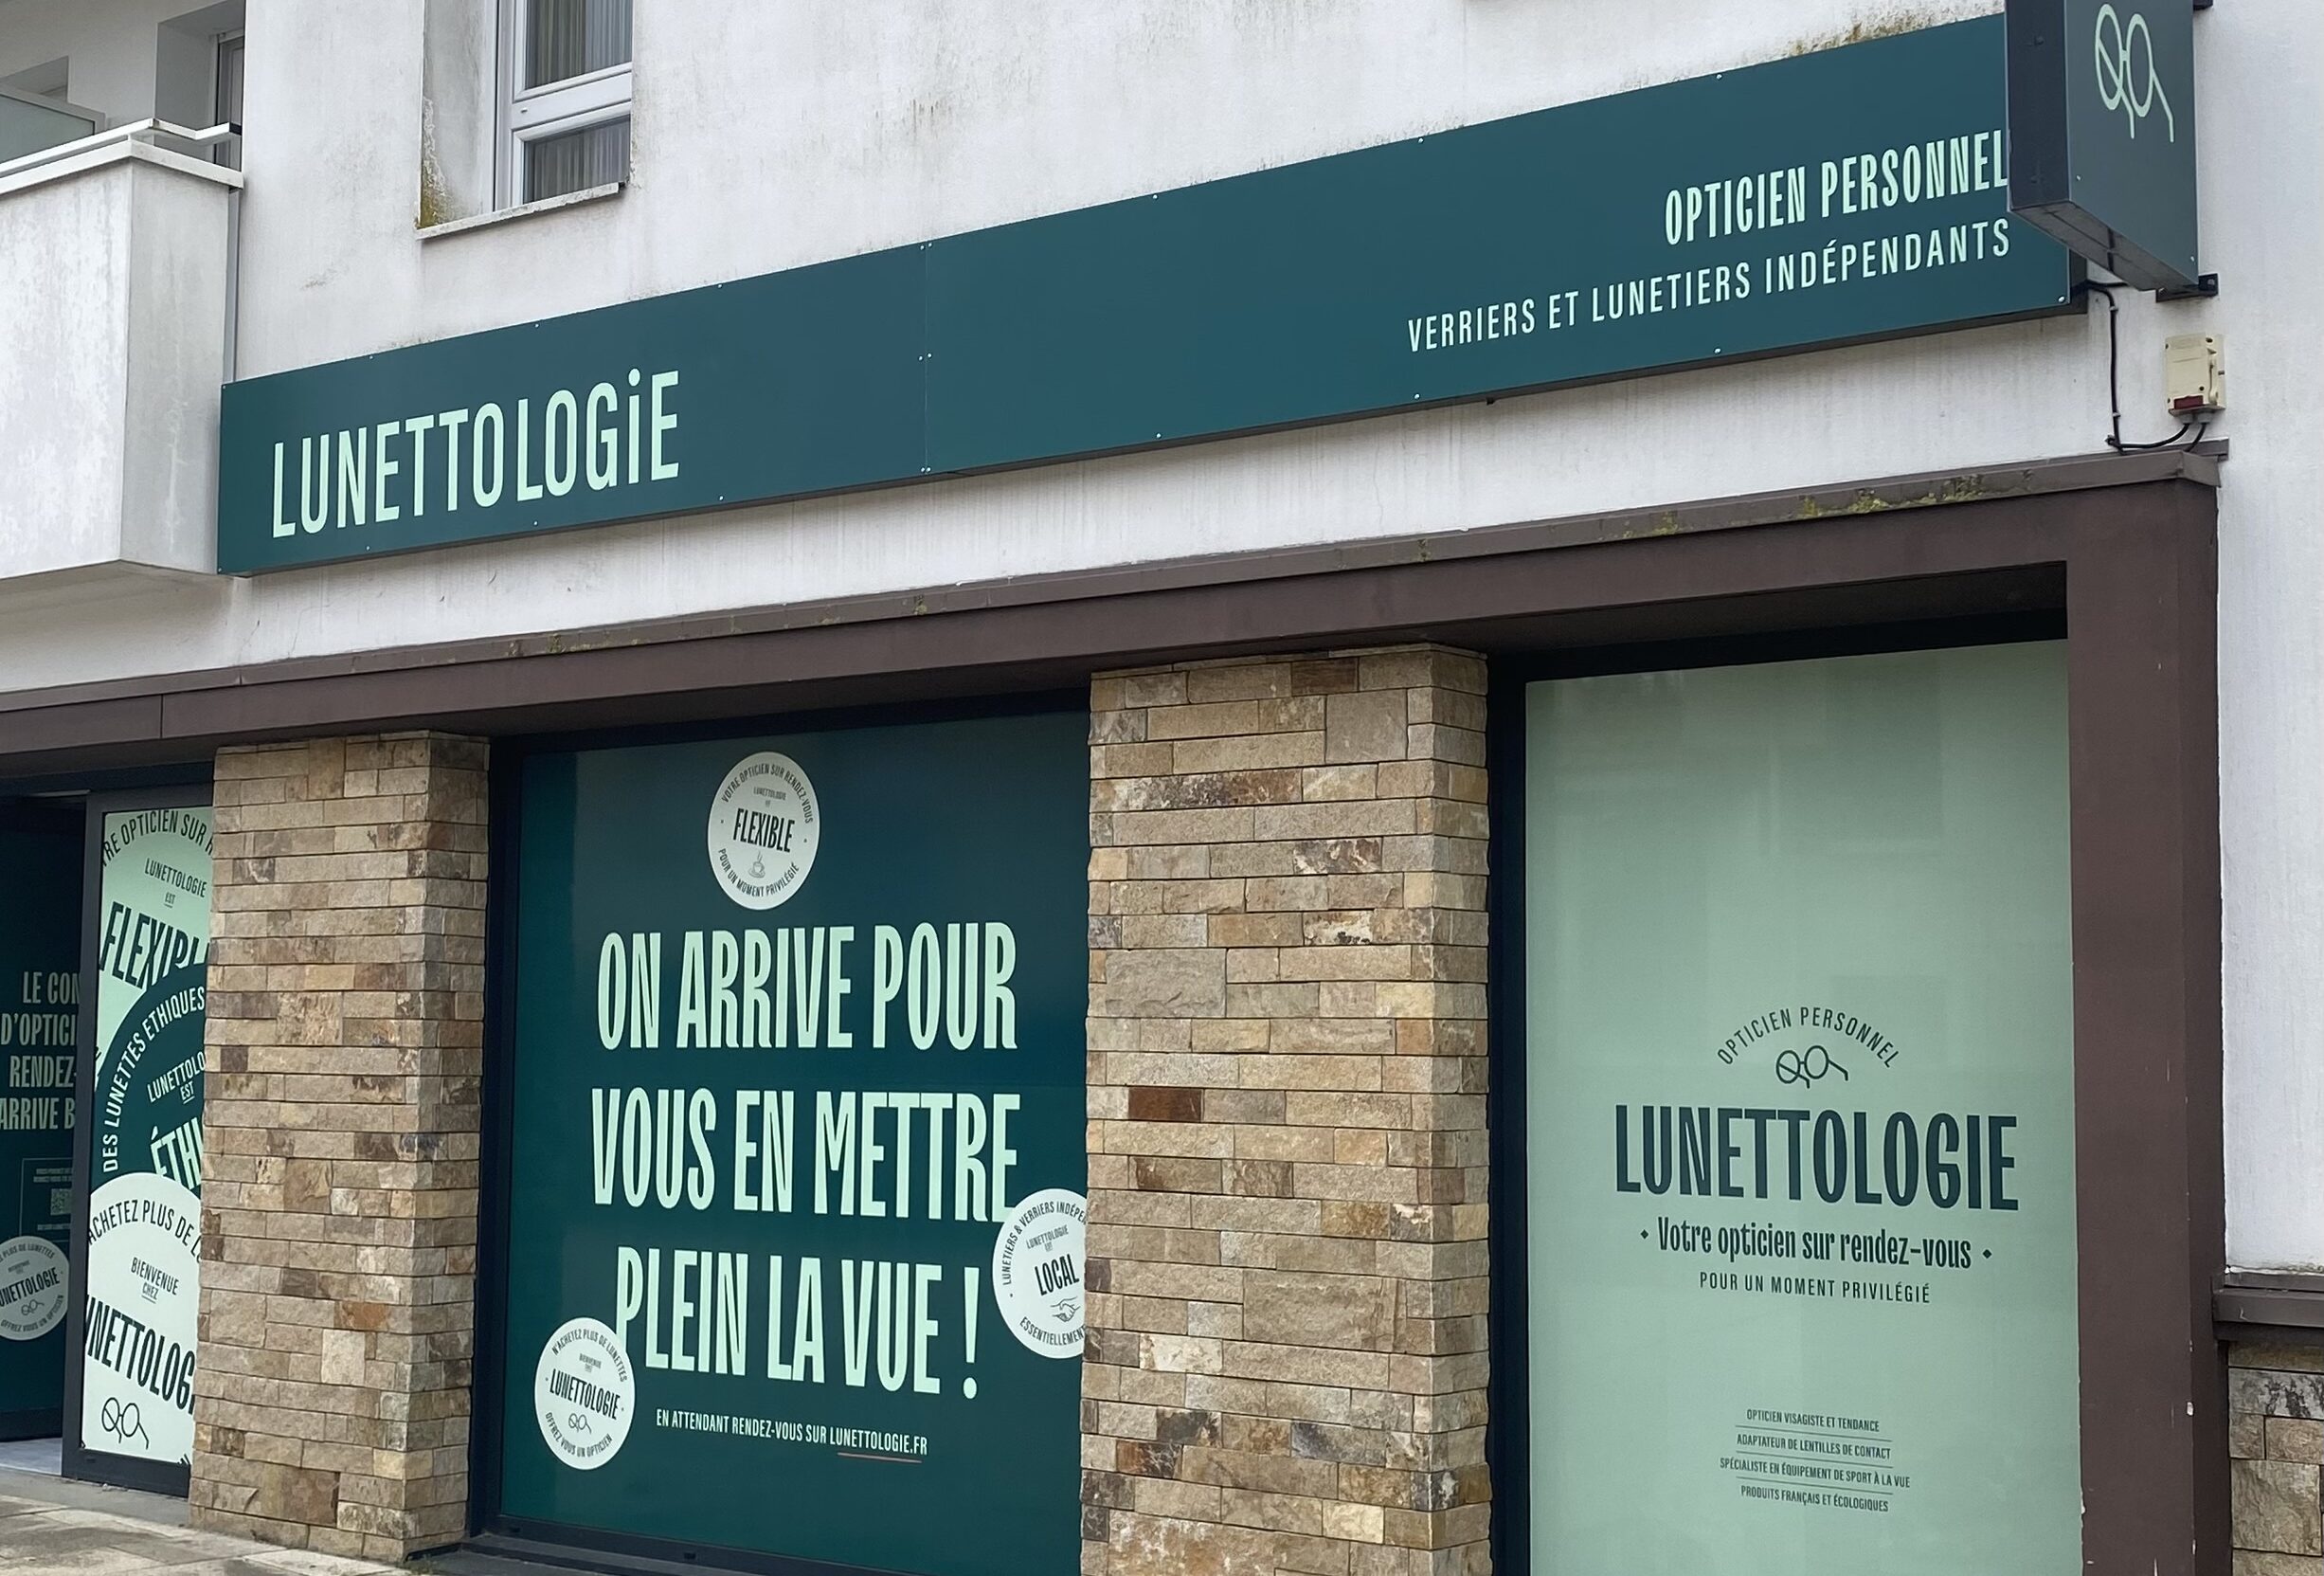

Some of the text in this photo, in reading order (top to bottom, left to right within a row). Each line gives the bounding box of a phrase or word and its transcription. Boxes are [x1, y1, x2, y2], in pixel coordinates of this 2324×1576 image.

[1664, 129, 2009, 245] OPTICIEN PERSONNEL
[1407, 218, 2010, 353] VERRIERS ET LUNETIERS INDÉPENDANTS
[721, 776, 741, 803] VOTRE
[739, 762, 769, 784] OPTICIEN
[770, 763, 785, 778] SUR
[102, 840, 121, 867] RE
[120, 809, 179, 846] OPTICIEN
[180, 813, 207, 847] SUR
[732, 807, 796, 853] FLEXIBLE
[144, 857, 207, 899] LUNETTOLOGIE
[718, 847, 730, 873] POUR
[727, 869, 738, 884] UN
[735, 878, 765, 897] MOMENT
[164, 891, 176, 905] EST
[22, 970, 44, 1005] LE
[597, 921, 1018, 1051] ON ARRIVE POUR
[1717, 1005, 1900, 1069] OPTICIEN PERSONNEL
[101, 986, 206, 1174] DES LUNETTES ETHIQUES
[147, 1050, 207, 1104] LUNETTOLO
[180, 1080, 195, 1101] EST
[0, 1096, 61, 1131] ARRIVE
[591, 1087, 1021, 1223] VOUS EN METTRE
[1614, 1104, 2020, 1212] LUNETTOLOGIE
[141, 1199, 175, 1232] PLUS
[174, 1215, 195, 1247] DE
[1000, 1231, 1019, 1286] LUNETIERS
[1013, 1224, 1023, 1236] &
[1018, 1200, 1055, 1228] VERRIERS
[1657, 1215, 1973, 1271] Votre opticien sur rendez-vous
[131, 1256, 180, 1296] BIENVENUE
[1034, 1253, 1080, 1296] LOCAL
[1699, 1271, 1932, 1304] POUR UN MOMENT PRIVILÉGIÉ
[615, 1245, 981, 1400] PLEIN LA VUE !
[85, 1295, 196, 1416] NETTOLOG
[549, 1368, 622, 1421] LUNETTOLOGIE
[545, 1411, 561, 1442] OFFREZ
[656, 1408, 928, 1456] EN ATTENDANT RENDEZ-VOUS SUR LUNETTOLOGIE.FR
[1746, 1408, 1881, 1433] OPTICIEN VISAGISTE ET TENDANCE
[1736, 1433, 1891, 1460] ADAPTATEUR DE LENTILLES DE CONTACT
[1720, 1457, 1911, 1489] SPÉCIALISTE EN ÉQUIPEMENT DE SPORT À LA VUE
[1740, 1484, 1889, 1513] PRODUITS FRANÇAIS ET ÉCOLOGIQUES
